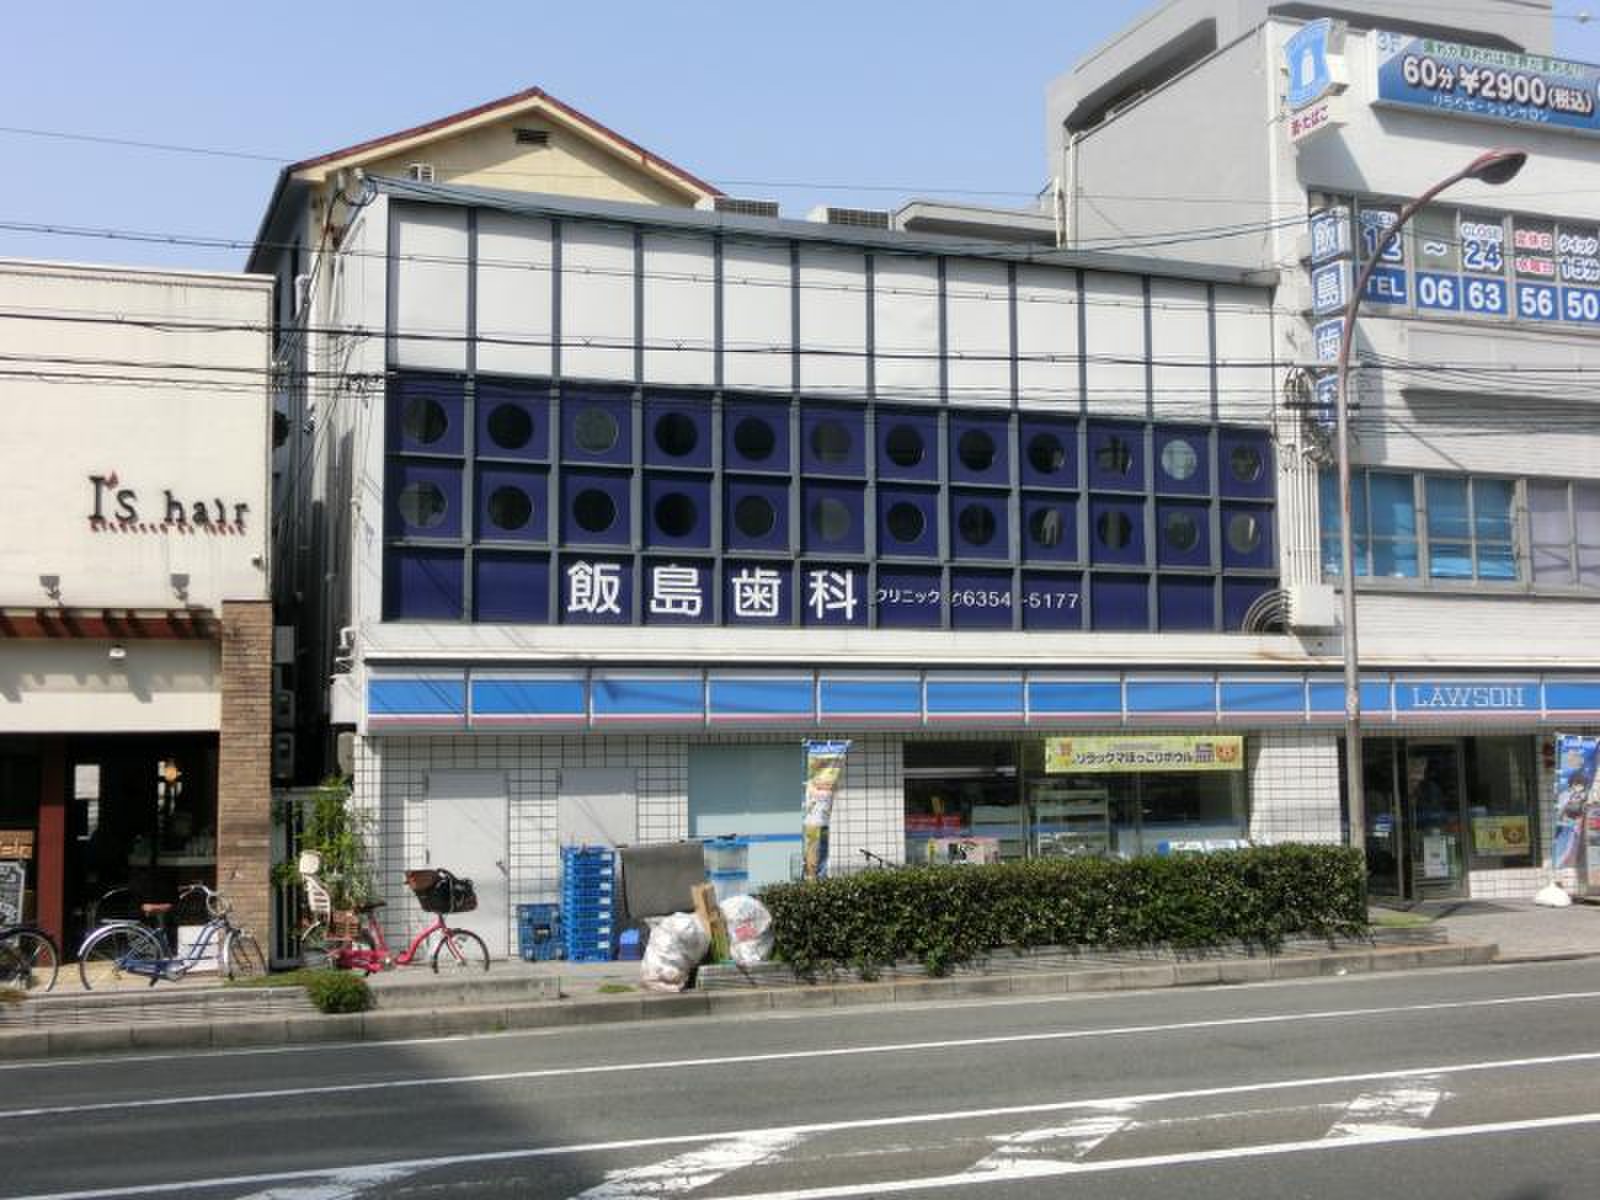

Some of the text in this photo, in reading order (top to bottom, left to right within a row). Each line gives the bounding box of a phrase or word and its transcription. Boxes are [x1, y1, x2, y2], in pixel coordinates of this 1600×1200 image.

[1402, 54, 1455, 90] 60分
[1363, 226, 1402, 261] 12
[1464, 239, 1503, 272] 24
[1366, 276, 1599, 320] TEL 06 63 56 50
[163, 490, 250, 526] hair
[567, 560, 857, 620] 飯島歯科
[877, 588, 941, 604] クリニック
[1412, 687, 1525, 708] LAWSON
